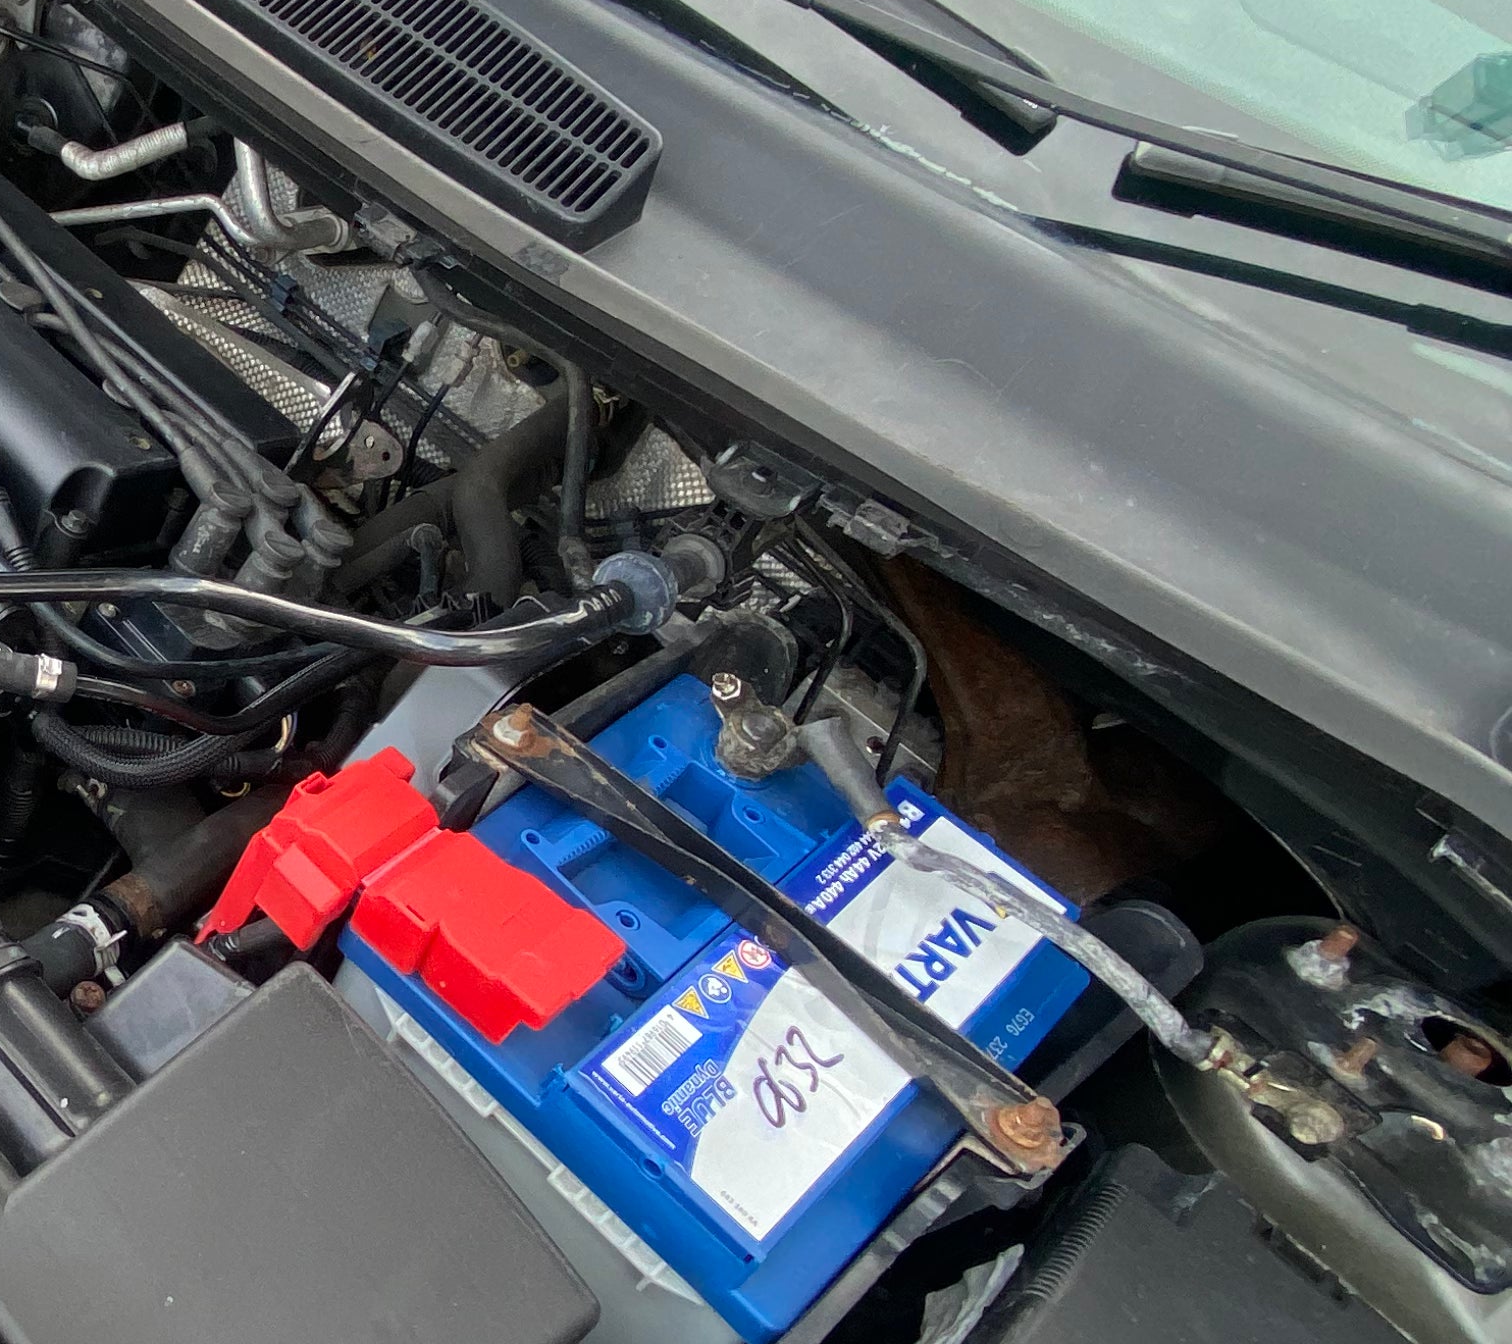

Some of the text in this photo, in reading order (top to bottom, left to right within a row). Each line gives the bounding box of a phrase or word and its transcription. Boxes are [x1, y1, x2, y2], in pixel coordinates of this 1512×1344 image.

[837, 855, 871, 884] 44Ah
[893, 908, 997, 1004] VART
[659, 1058, 721, 1116] Dynamic
[676, 1074, 737, 1138] BLUE
